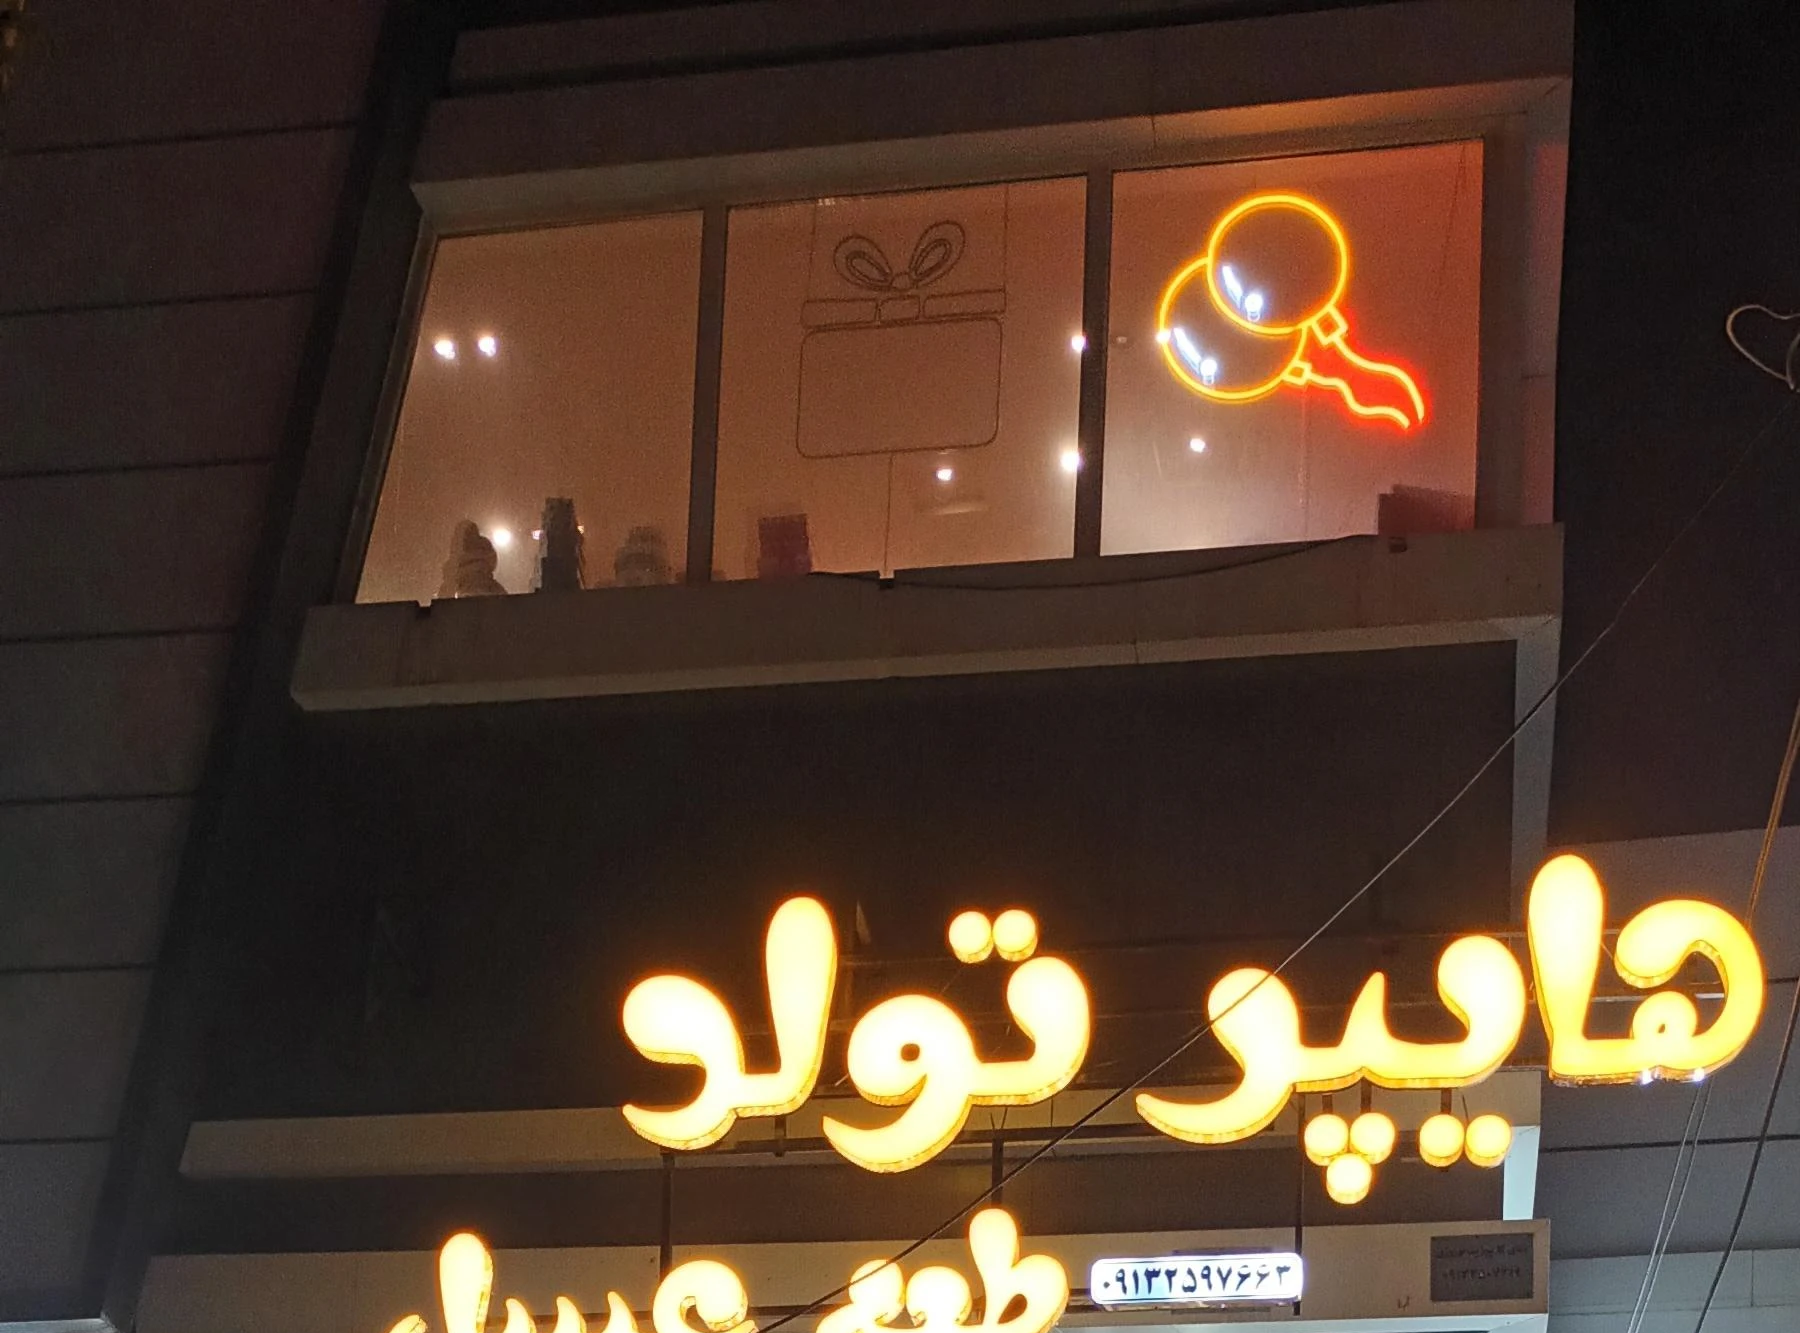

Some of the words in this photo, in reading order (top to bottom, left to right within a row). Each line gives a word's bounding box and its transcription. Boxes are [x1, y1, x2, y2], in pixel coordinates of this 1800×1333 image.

[622, 896, 1091, 1173] تولد
[1136, 853, 1766, 1205] هایپر
[1103, 1264, 1291, 1295] ۰۹۱۳۲۵۹۷۶۶۳
